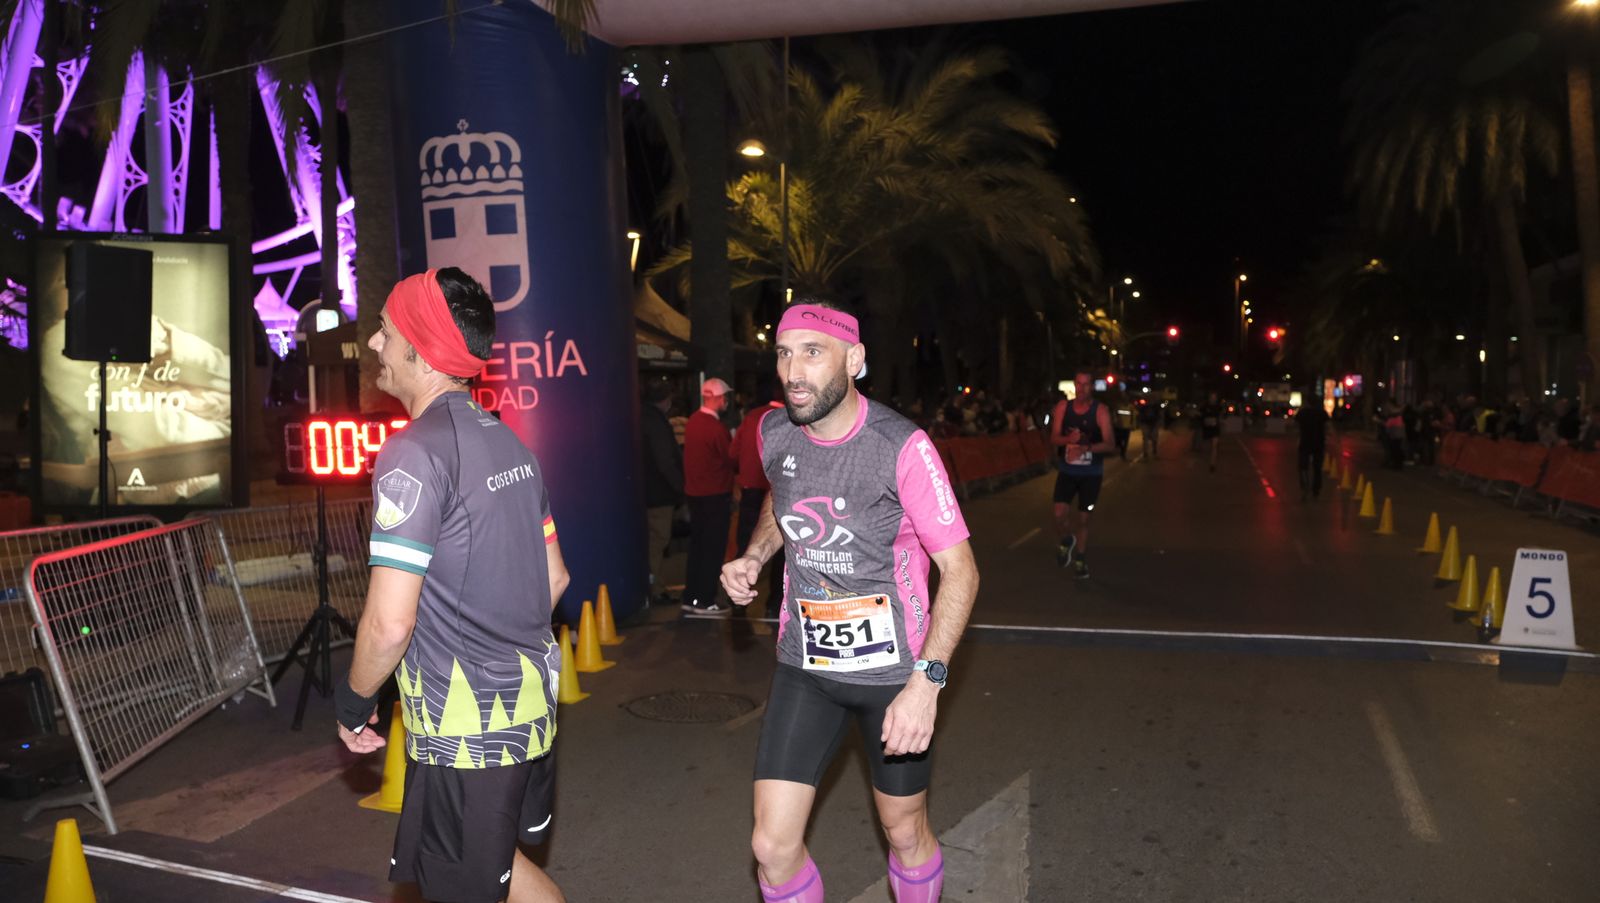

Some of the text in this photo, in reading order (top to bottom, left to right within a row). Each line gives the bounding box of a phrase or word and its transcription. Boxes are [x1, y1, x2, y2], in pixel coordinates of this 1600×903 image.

[480, 331, 588, 381] ERÍA
[153, 360, 181, 382] de
[84, 382, 187, 413] futuro
[472, 385, 539, 412] DAD
[308, 420, 409, 475] 00:4
[486, 463, 535, 492] COSENTIN
[805, 548, 853, 563] TRIATLON
[1520, 552, 1565, 561] MONDO
[1525, 576, 1556, 619] 5
[816, 618, 874, 647] 251
